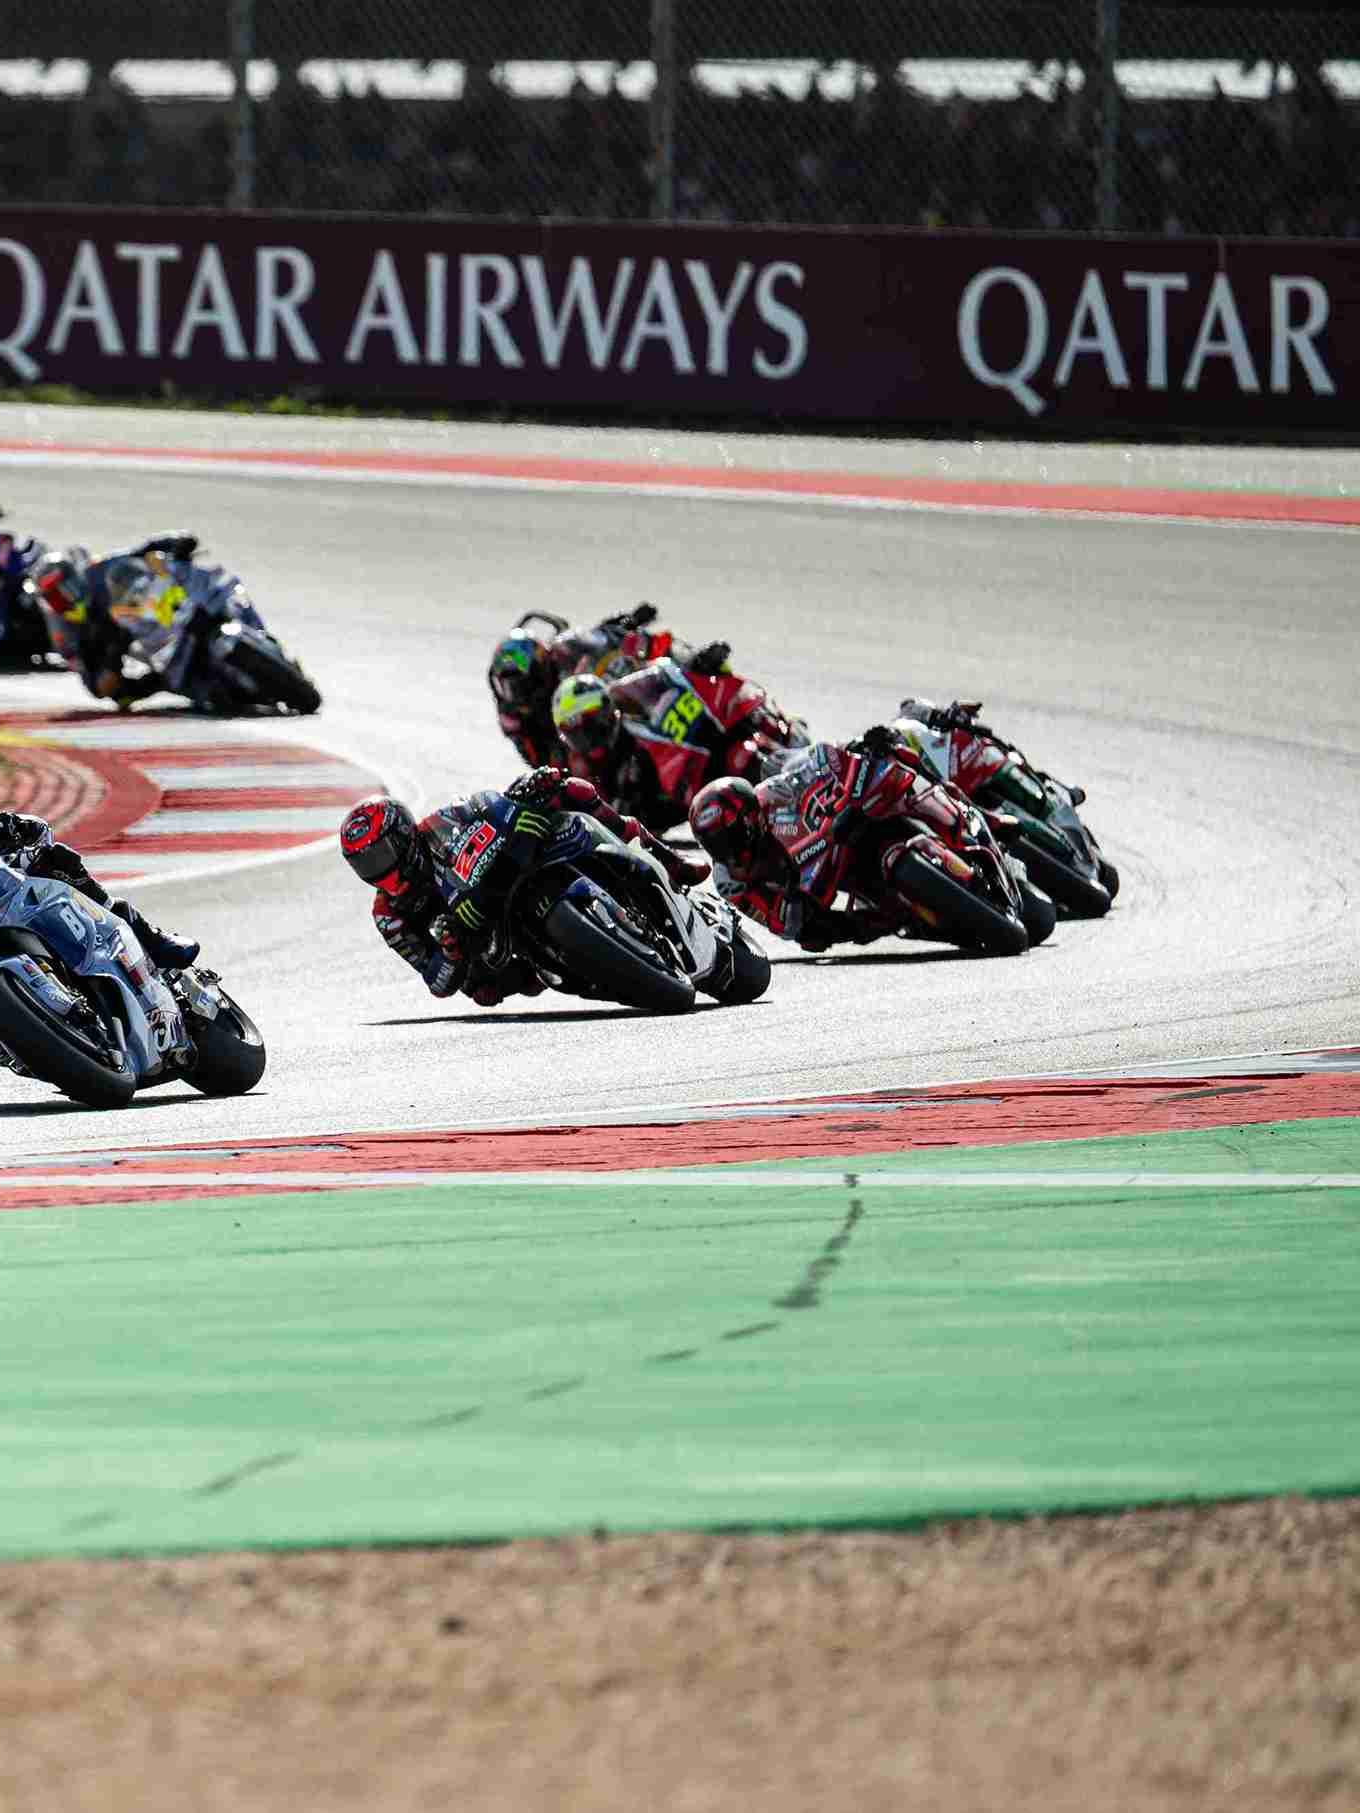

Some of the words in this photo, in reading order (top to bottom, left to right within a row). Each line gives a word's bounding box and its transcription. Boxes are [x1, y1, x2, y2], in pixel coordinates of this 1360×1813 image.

[346, 250, 807, 378] AIRWAYS
[959, 268, 1334, 412] QATAR
[662, 691, 704, 745] 36
